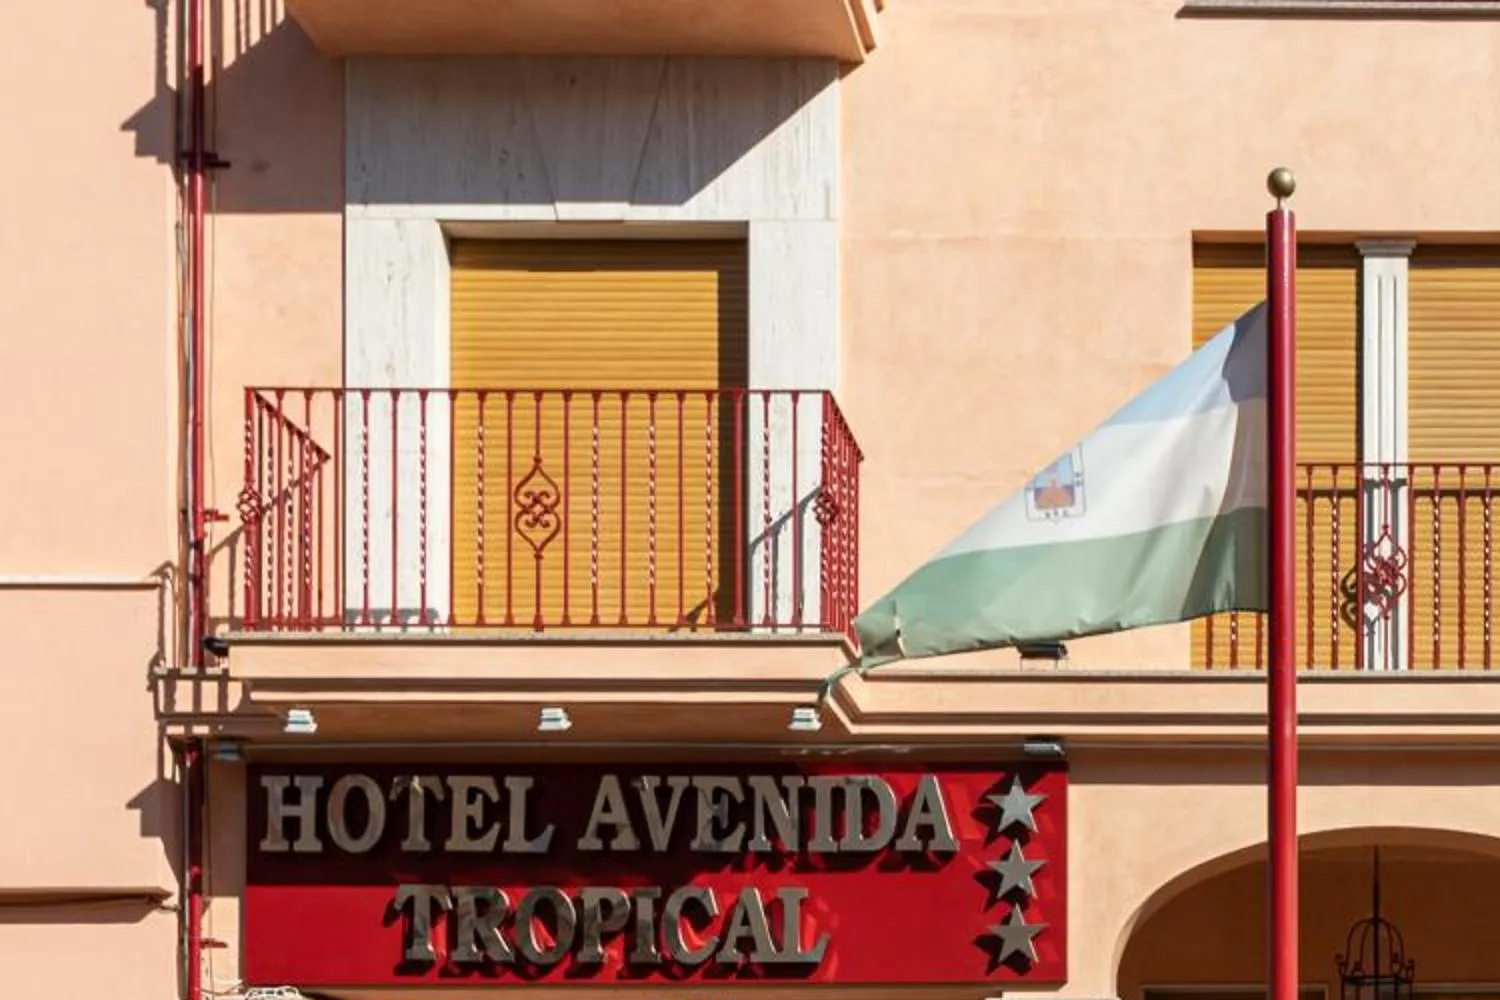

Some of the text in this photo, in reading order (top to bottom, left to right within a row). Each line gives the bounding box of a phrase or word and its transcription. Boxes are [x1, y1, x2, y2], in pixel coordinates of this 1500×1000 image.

[259, 774, 960, 853] HOTEL AVENIDA
[395, 884, 829, 964] TROPICAL
